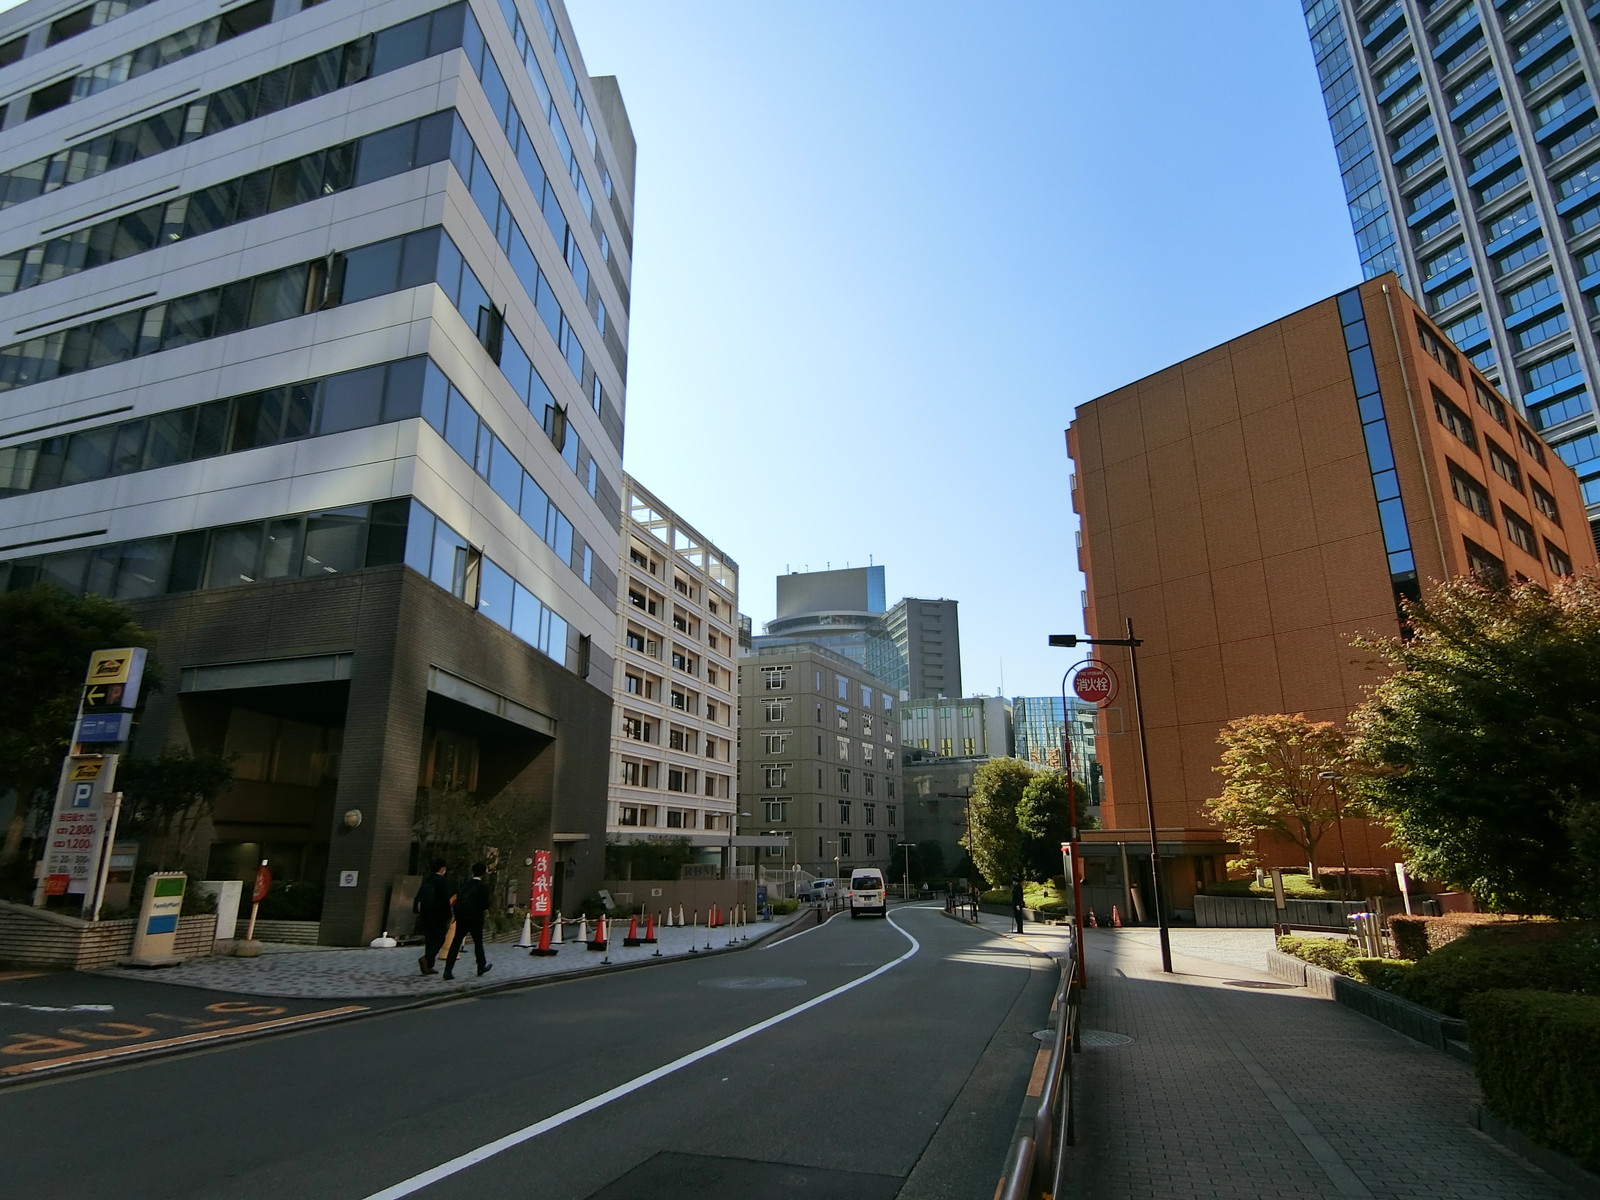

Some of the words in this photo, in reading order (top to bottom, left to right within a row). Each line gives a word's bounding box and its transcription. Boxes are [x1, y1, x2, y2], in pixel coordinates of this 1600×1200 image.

[97, 662, 122, 675] Times
[1076, 677, 1108, 692] 消火栓
[76, 767, 99, 778] Times
[74, 784, 91, 806] P
[0, 1001, 288, 1055] STOP
